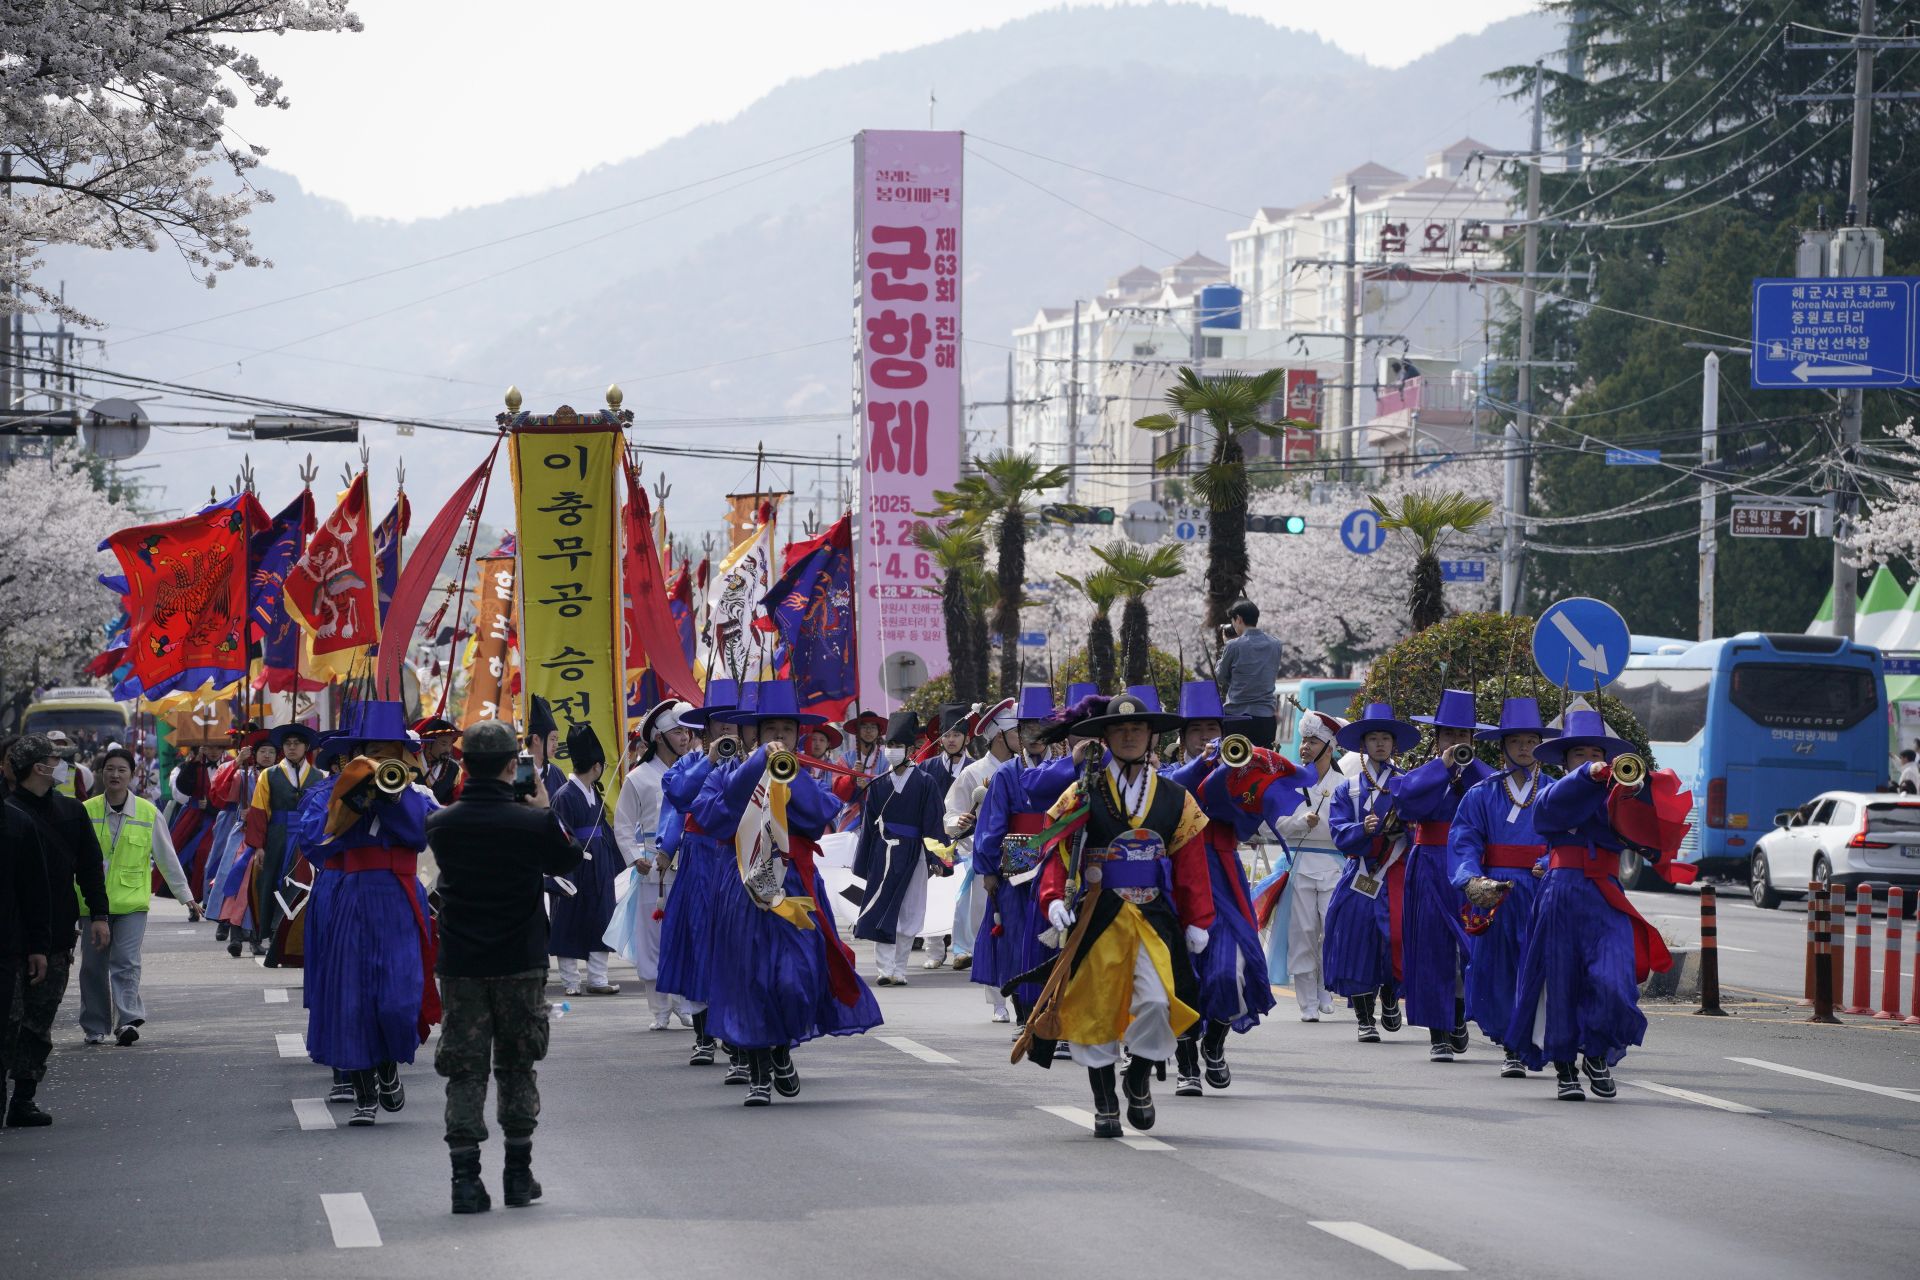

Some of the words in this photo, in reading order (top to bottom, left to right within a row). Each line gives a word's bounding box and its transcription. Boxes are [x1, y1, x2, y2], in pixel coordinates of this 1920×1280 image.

[1380, 222, 1527, 253] 삼오모
[934, 227, 957, 302] 제63회
[1791, 286, 1888, 298] 해군사관학교
[1791, 300, 1820, 309] Korea
[1821, 300, 1849, 309] Naval
[1850, 300, 1896, 311] Academy
[1791, 310, 1865, 324] 중원로터리
[1791, 325, 1842, 335] Jungwon
[1843, 325, 1864, 334] Rot
[935, 316, 955, 368] 진해
[1790, 337, 1829, 350] 유람선
[1831, 337, 1870, 350] 선착장
[866, 225, 932, 476] 군항제
[1790, 352, 1818, 362] Ferry
[1821, 351, 1868, 361] Terminal
[869, 494, 915, 513] 2025.
[1736, 510, 1783, 524] 손원일로
[537, 445, 593, 618] 이충무공
[1764, 715, 1845, 725] UNIVERSE
